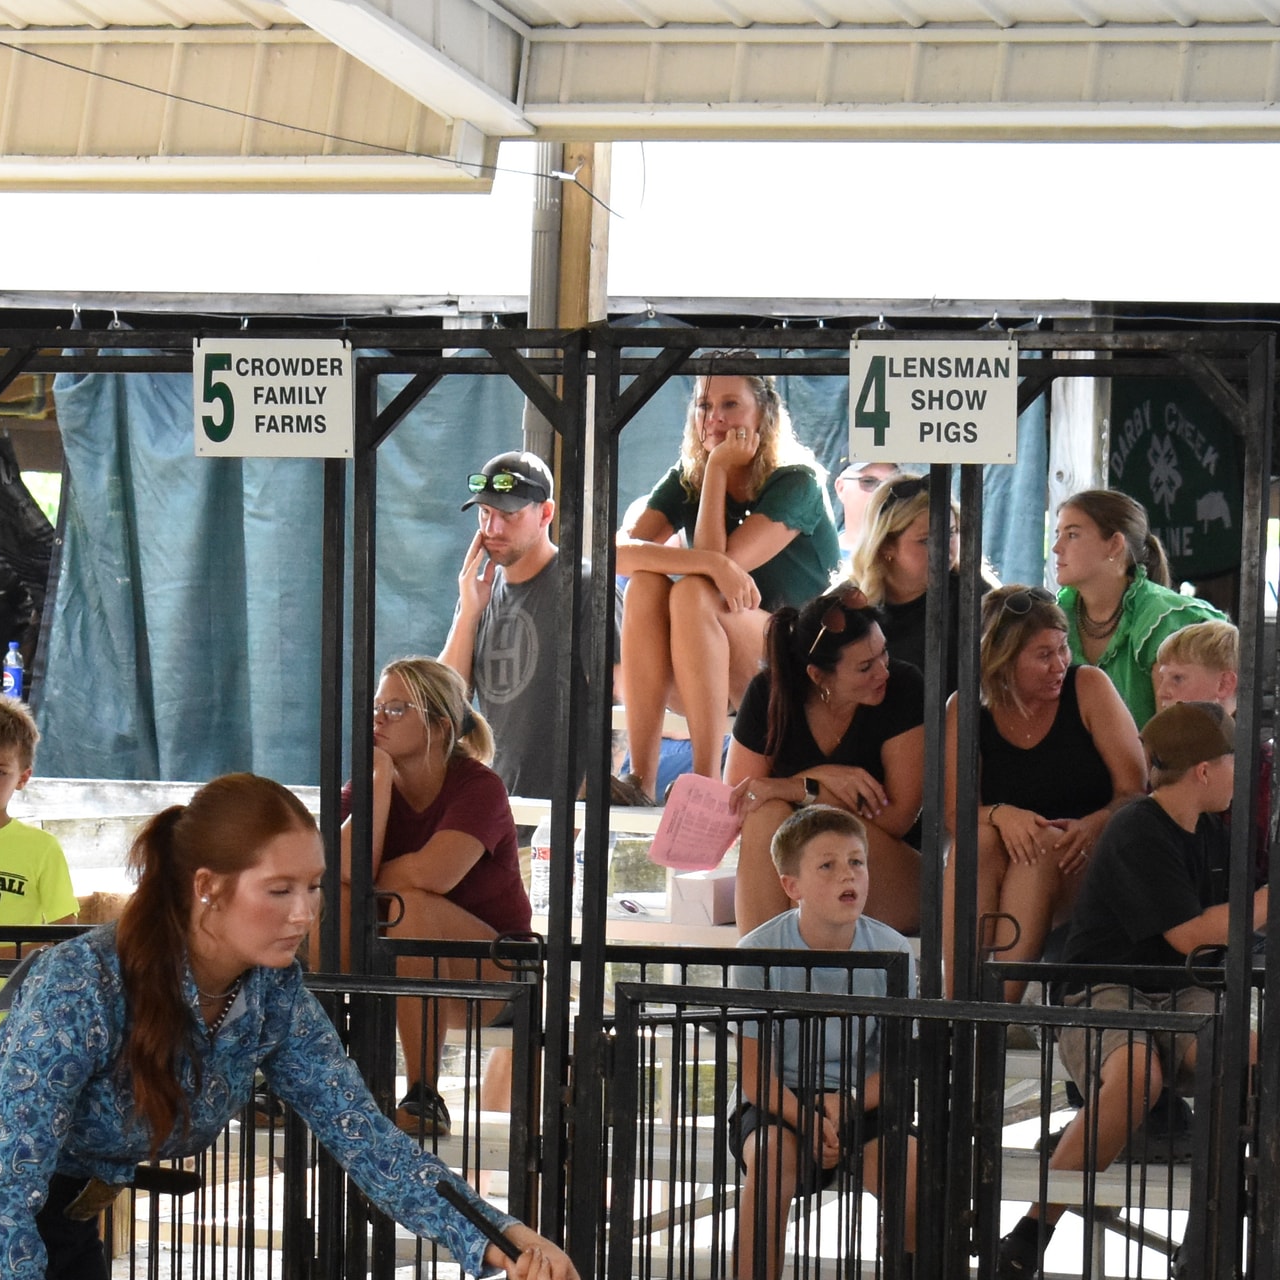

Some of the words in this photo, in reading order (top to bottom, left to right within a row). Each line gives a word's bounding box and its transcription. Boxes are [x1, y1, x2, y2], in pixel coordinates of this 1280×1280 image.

[236, 358, 342, 376] CROWDER
[889, 357, 1009, 378] LENSMAN
[201, 352, 233, 443] 5
[254, 387, 327, 404] FAMILY
[855, 356, 890, 446] 4
[911, 389, 987, 410] SHOW
[255, 415, 326, 433] FARMS
[920, 422, 977, 443] PIGS
[1111, 400, 1151, 479] DARBY
[1165, 402, 1219, 476] CREEK
